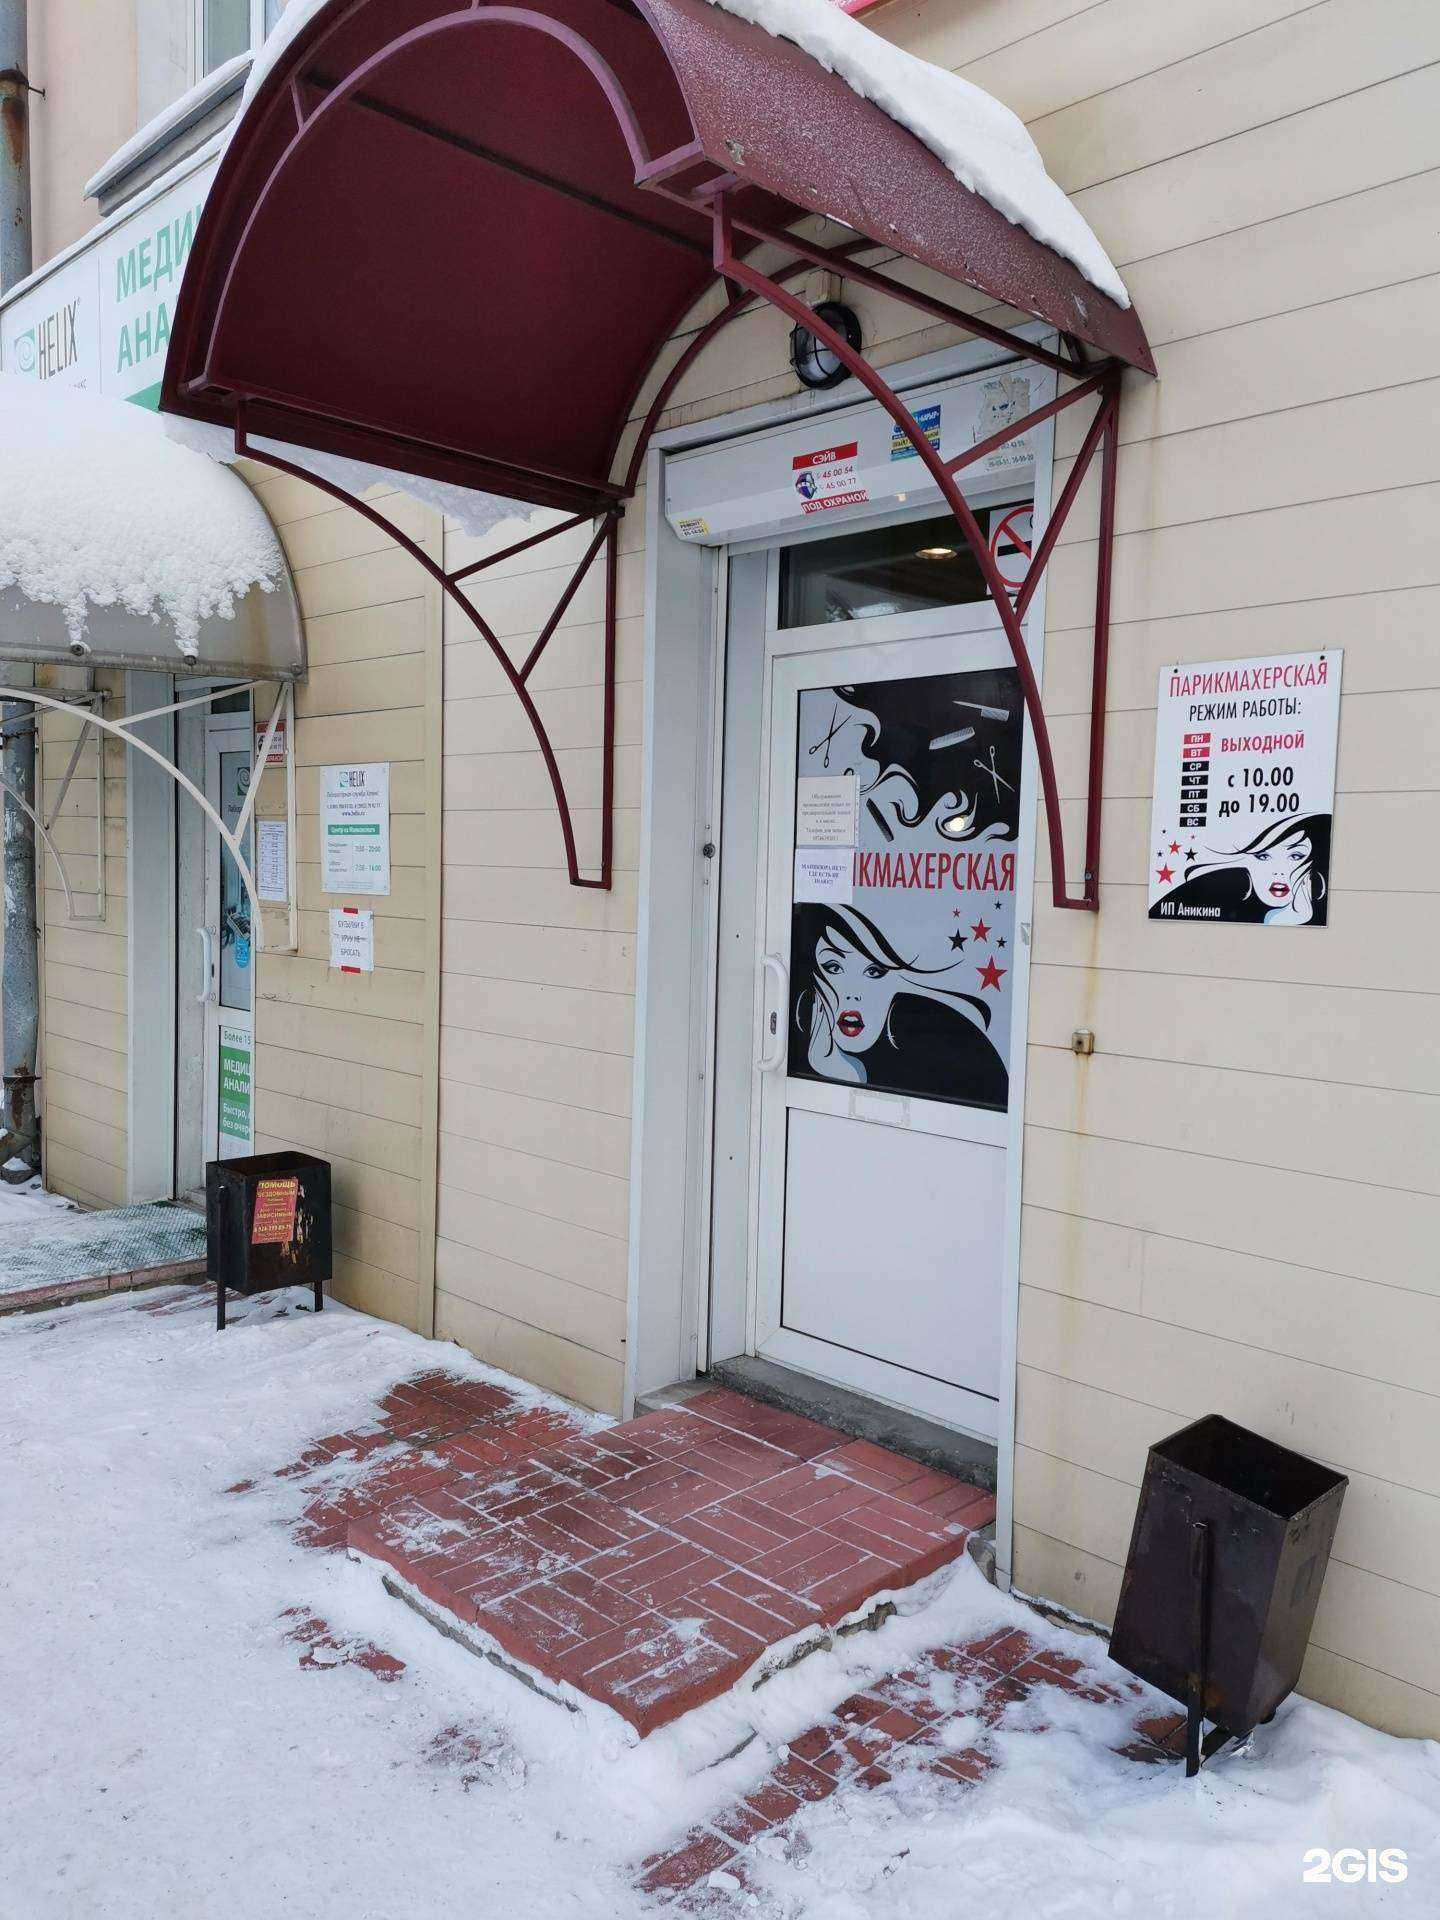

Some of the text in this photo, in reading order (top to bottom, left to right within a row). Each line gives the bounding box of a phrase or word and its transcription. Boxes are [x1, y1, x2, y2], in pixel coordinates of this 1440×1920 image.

[116, 205, 201, 303] МЕДИ
[38, 301, 78, 380] HELIX
[812, 450, 836, 464] СЭЙВ
[802, 491, 870, 514] ПОД ОХРАНОЙ
[1169, 662, 1328, 697] ПАРИКМАХЕРСКАЯ
[1189, 698, 1302, 722] РЕЖИМ РАБОТЫ:
[1191, 730, 1304, 753] ПН ВЫХОДНОЙ
[1190, 748, 1203, 758] ВТ
[1189, 762, 1202, 771] СР
[1188, 776, 1201, 785] ЧТ
[1243, 767, 1294, 788] 10.00
[1188, 790, 1201, 799] ПТ
[1187, 804, 1200, 813] СБ
[1218, 793, 1300, 817] до 19.00
[1186, 818, 1199, 827] ВС
[853, 852, 1016, 891] КМАХЕРСКАЯ
[1160, 901, 1175, 915] ИП
[223, 1030, 243, 1045] Более
